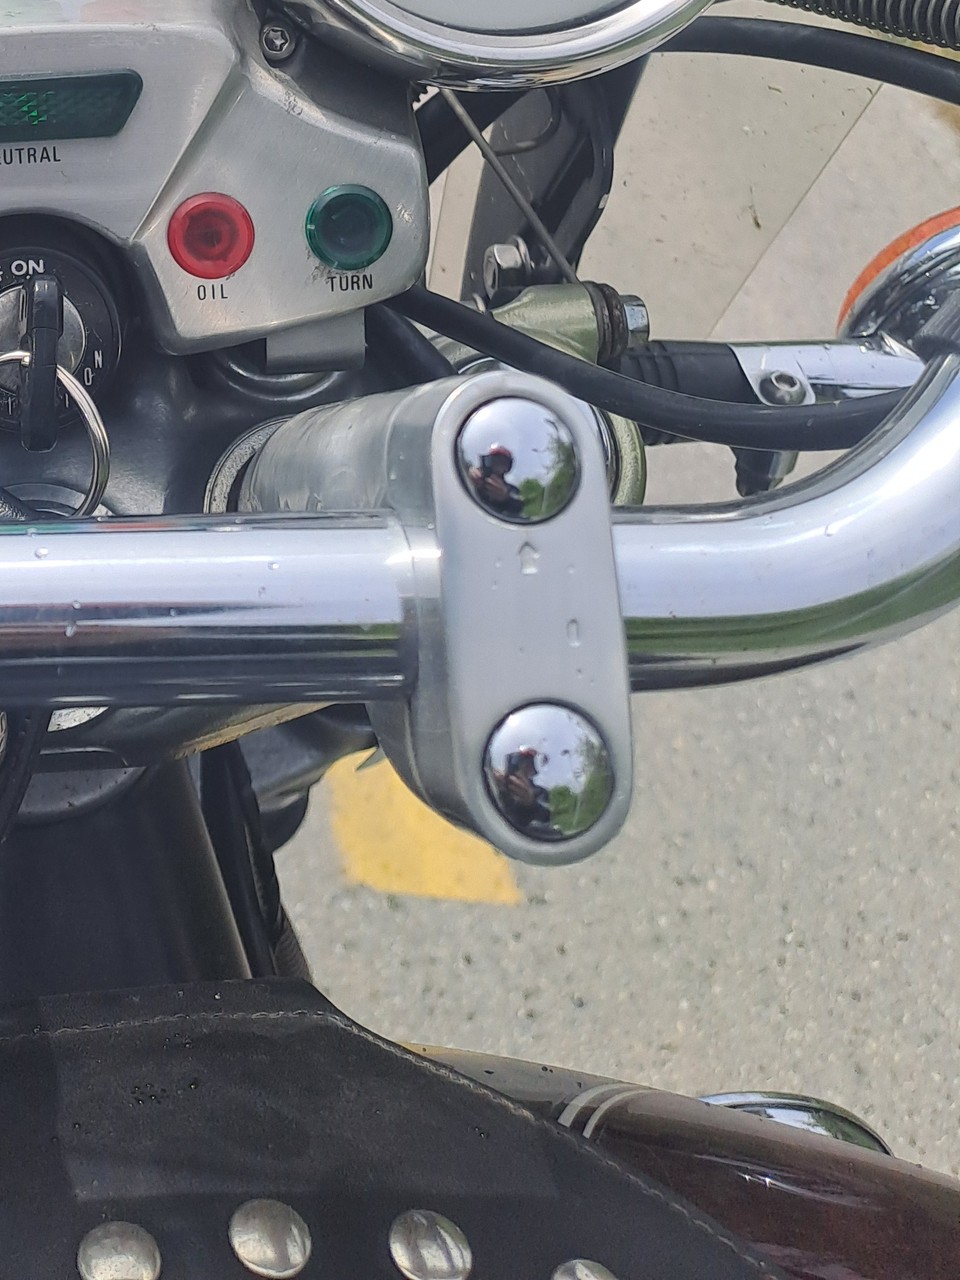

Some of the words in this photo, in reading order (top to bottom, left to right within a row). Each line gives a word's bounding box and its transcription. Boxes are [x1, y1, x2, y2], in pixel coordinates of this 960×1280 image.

[10, 259, 45, 276] ON
[196, 283, 229, 301] OIL
[327, 273, 374, 293] TURN
